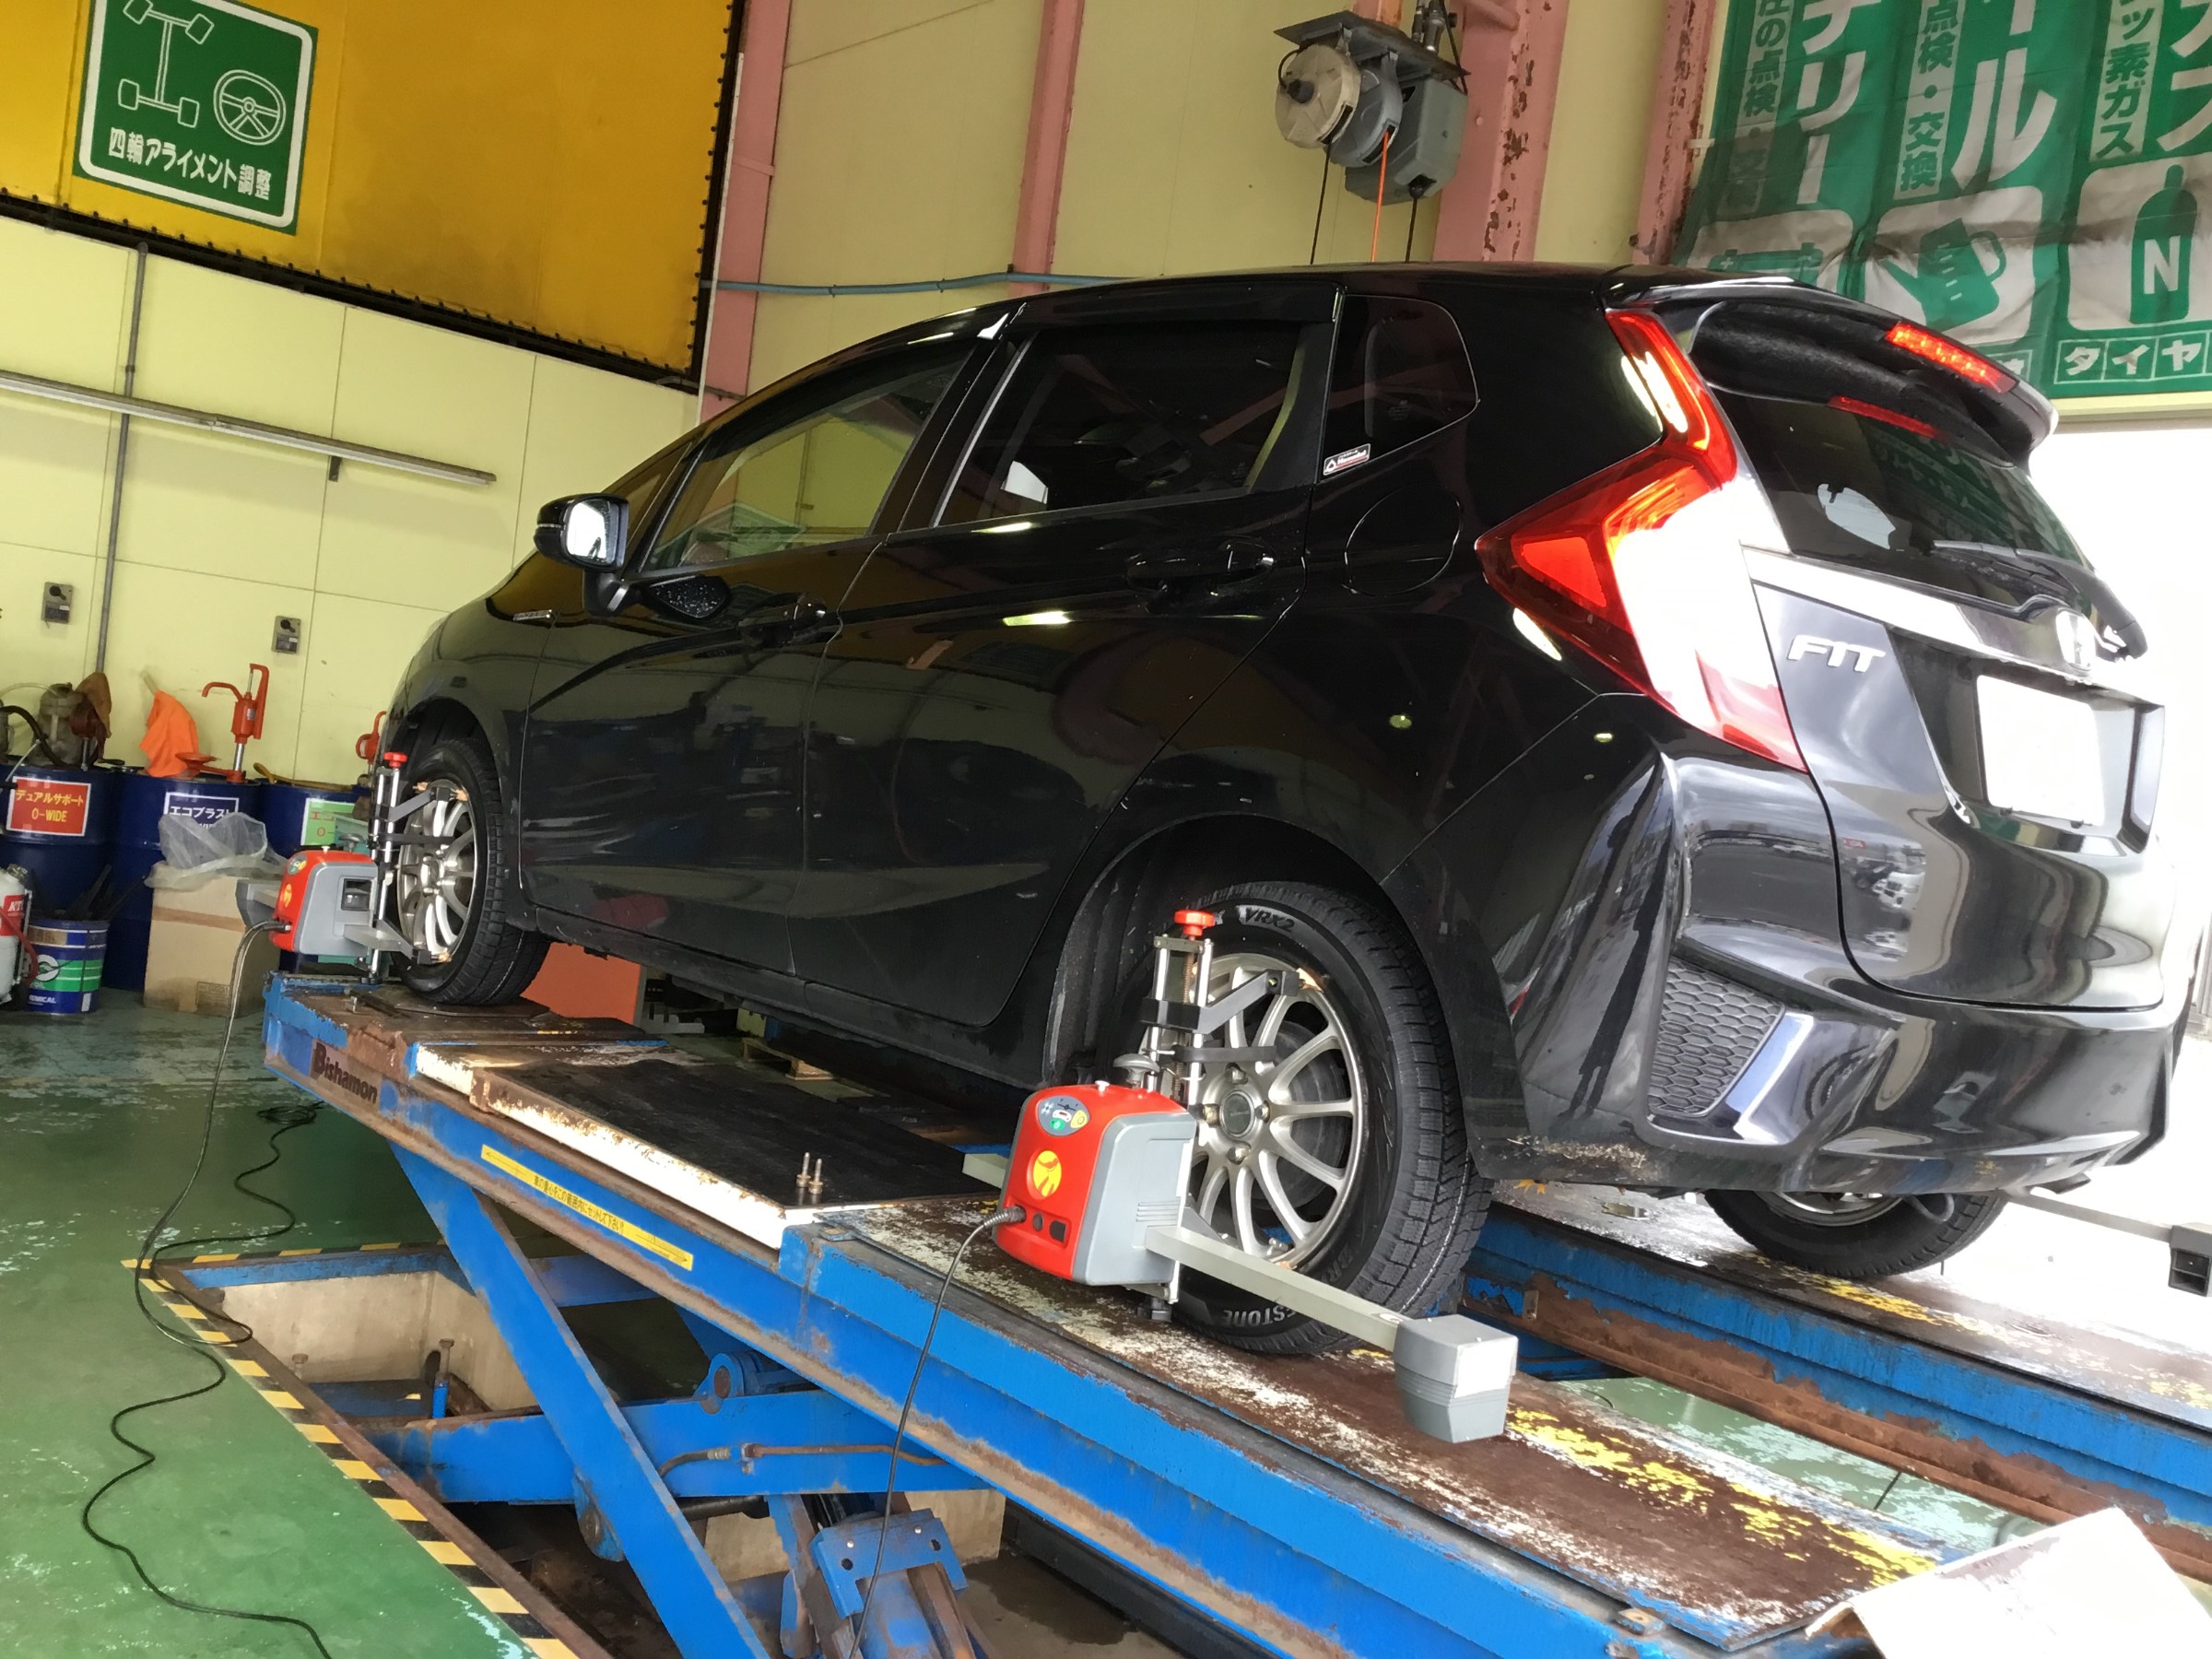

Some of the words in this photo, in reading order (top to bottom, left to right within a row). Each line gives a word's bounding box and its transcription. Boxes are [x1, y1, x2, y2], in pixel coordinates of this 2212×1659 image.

[2096, 0, 2155, 158] ッ素ガス
[108, 126, 272, 201] 四輪アライメント調整
[2144, 235, 2181, 294] N
[1787, 634, 1887, 673] FIT
[1245, 907, 1295, 932] VRX2
[313, 1041, 377, 1104] Bishamon
